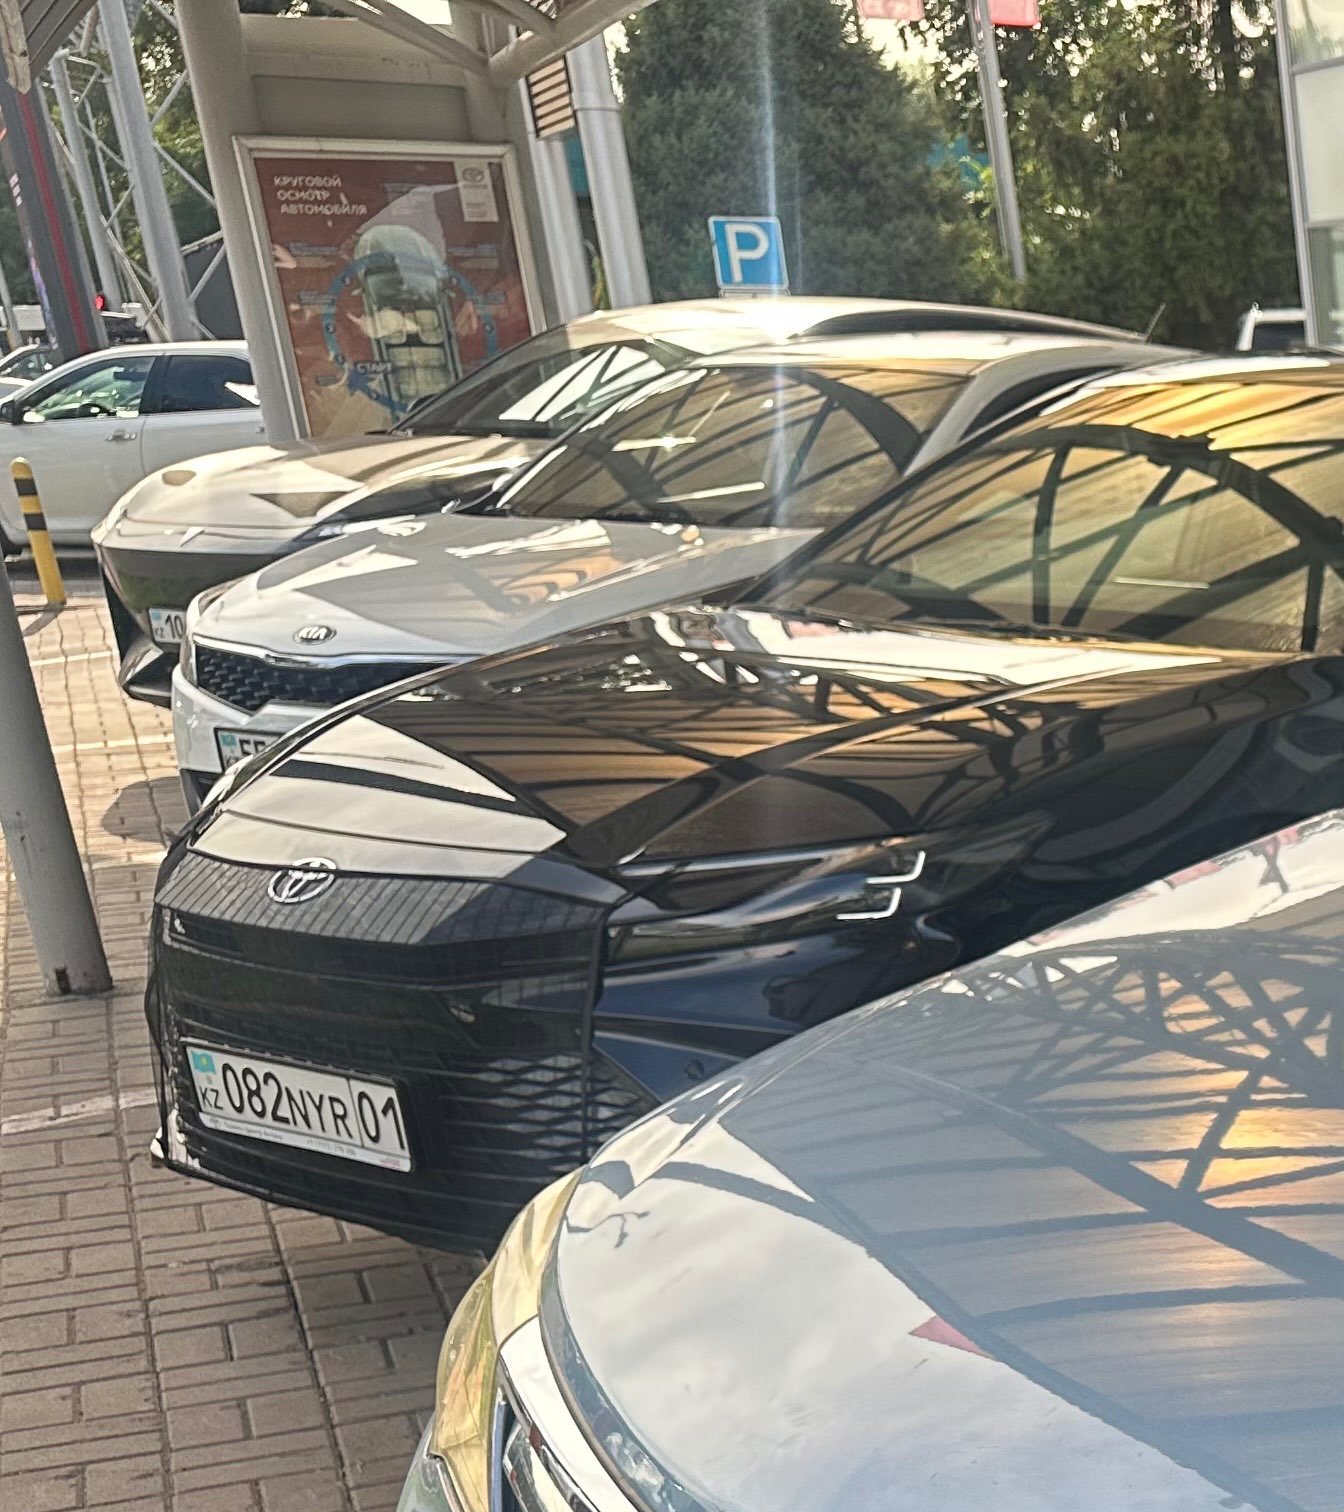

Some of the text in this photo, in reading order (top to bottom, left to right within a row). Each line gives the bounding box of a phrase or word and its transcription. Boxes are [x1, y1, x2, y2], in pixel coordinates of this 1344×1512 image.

[273, 174, 342, 188] КРУГОВОЙ
[277, 189, 330, 201] ОСМОТР
[281, 203, 368, 215] АВТОМОБИЛЯ
[724, 223, 769, 283] P
[200, 1086, 223, 1110] KZ
[222, 1063, 352, 1139] 082NYR
[358, 1091, 405, 1150] 01
